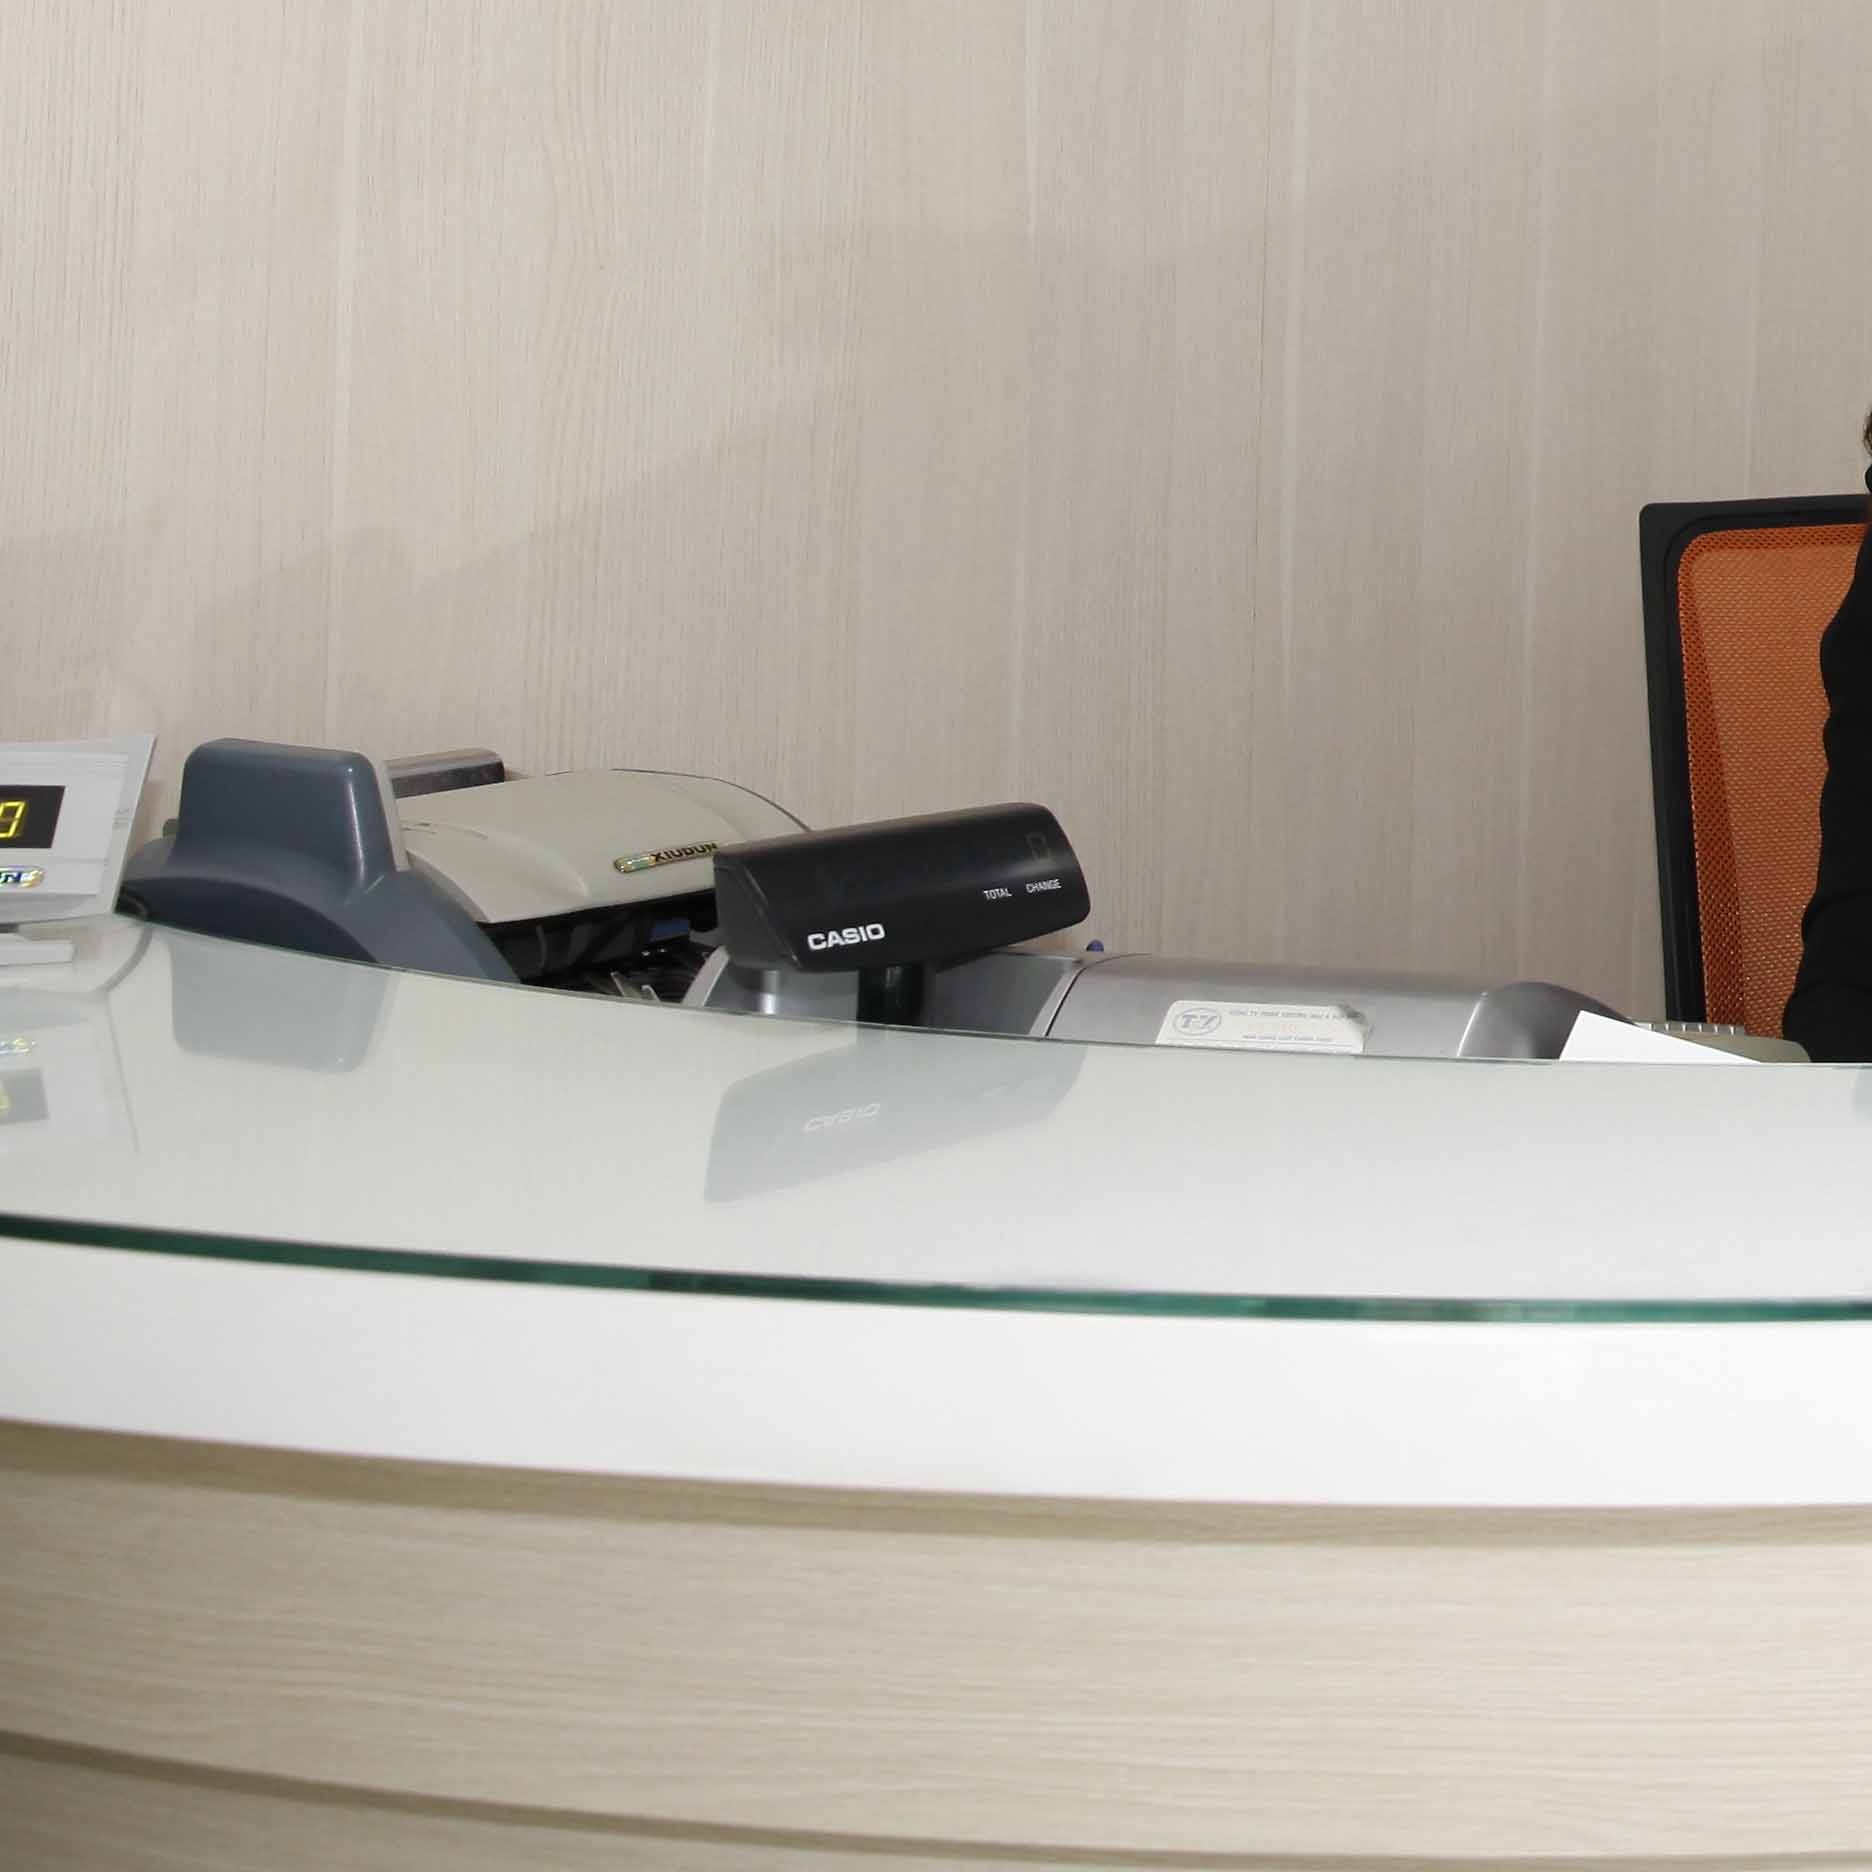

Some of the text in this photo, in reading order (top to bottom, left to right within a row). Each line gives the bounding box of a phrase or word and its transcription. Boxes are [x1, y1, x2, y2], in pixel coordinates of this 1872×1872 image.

[983, 878, 1062, 901] TOTAL CHANGE
[807, 923, 886, 951] CASIO
